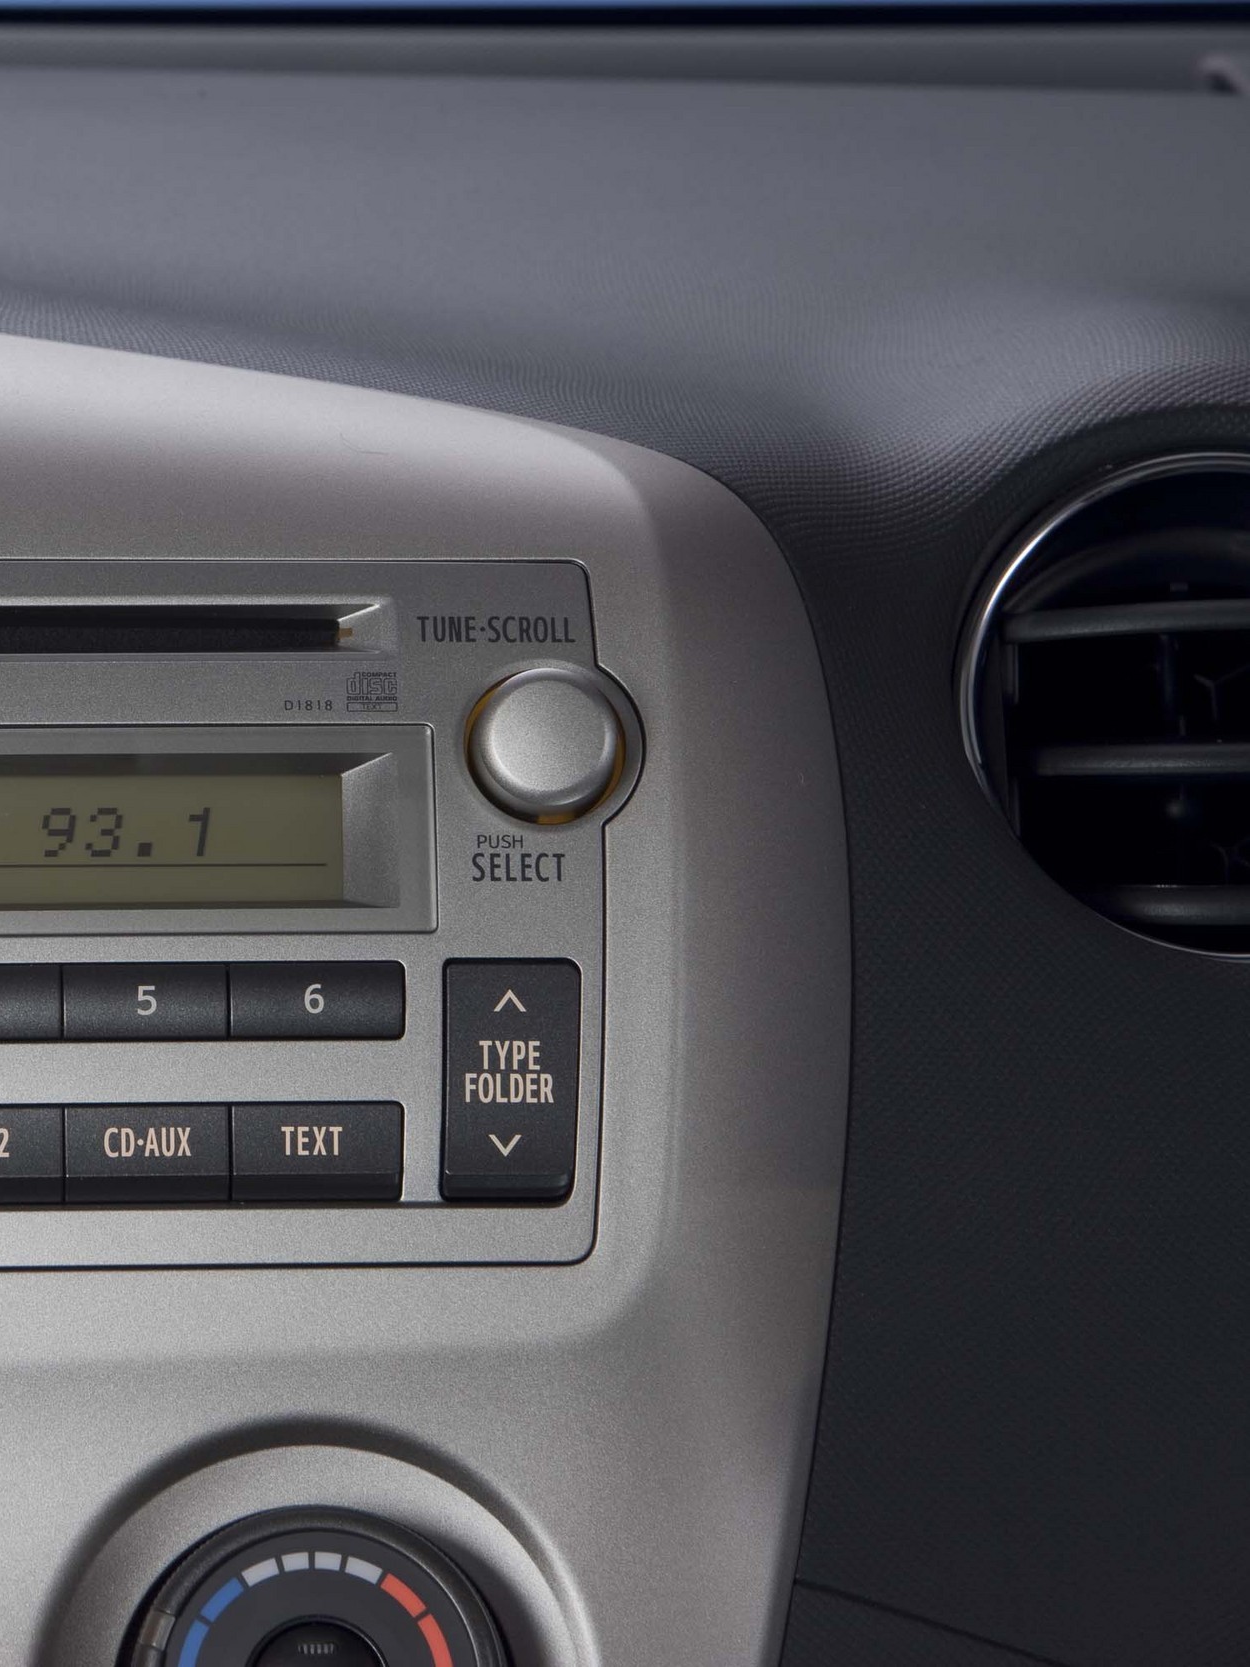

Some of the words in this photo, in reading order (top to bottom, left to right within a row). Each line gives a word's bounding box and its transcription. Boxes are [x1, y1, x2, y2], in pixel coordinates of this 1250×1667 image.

[477, 834, 524, 848] PUSH
[472, 853, 566, 882] SELECT
[136, 985, 157, 1015] 5
[303, 983, 325, 1013] 6
[479, 1040, 541, 1070] TYPE
[464, 1072, 554, 1104] FOLDER
[281, 1125, 343, 1156] TEXT
